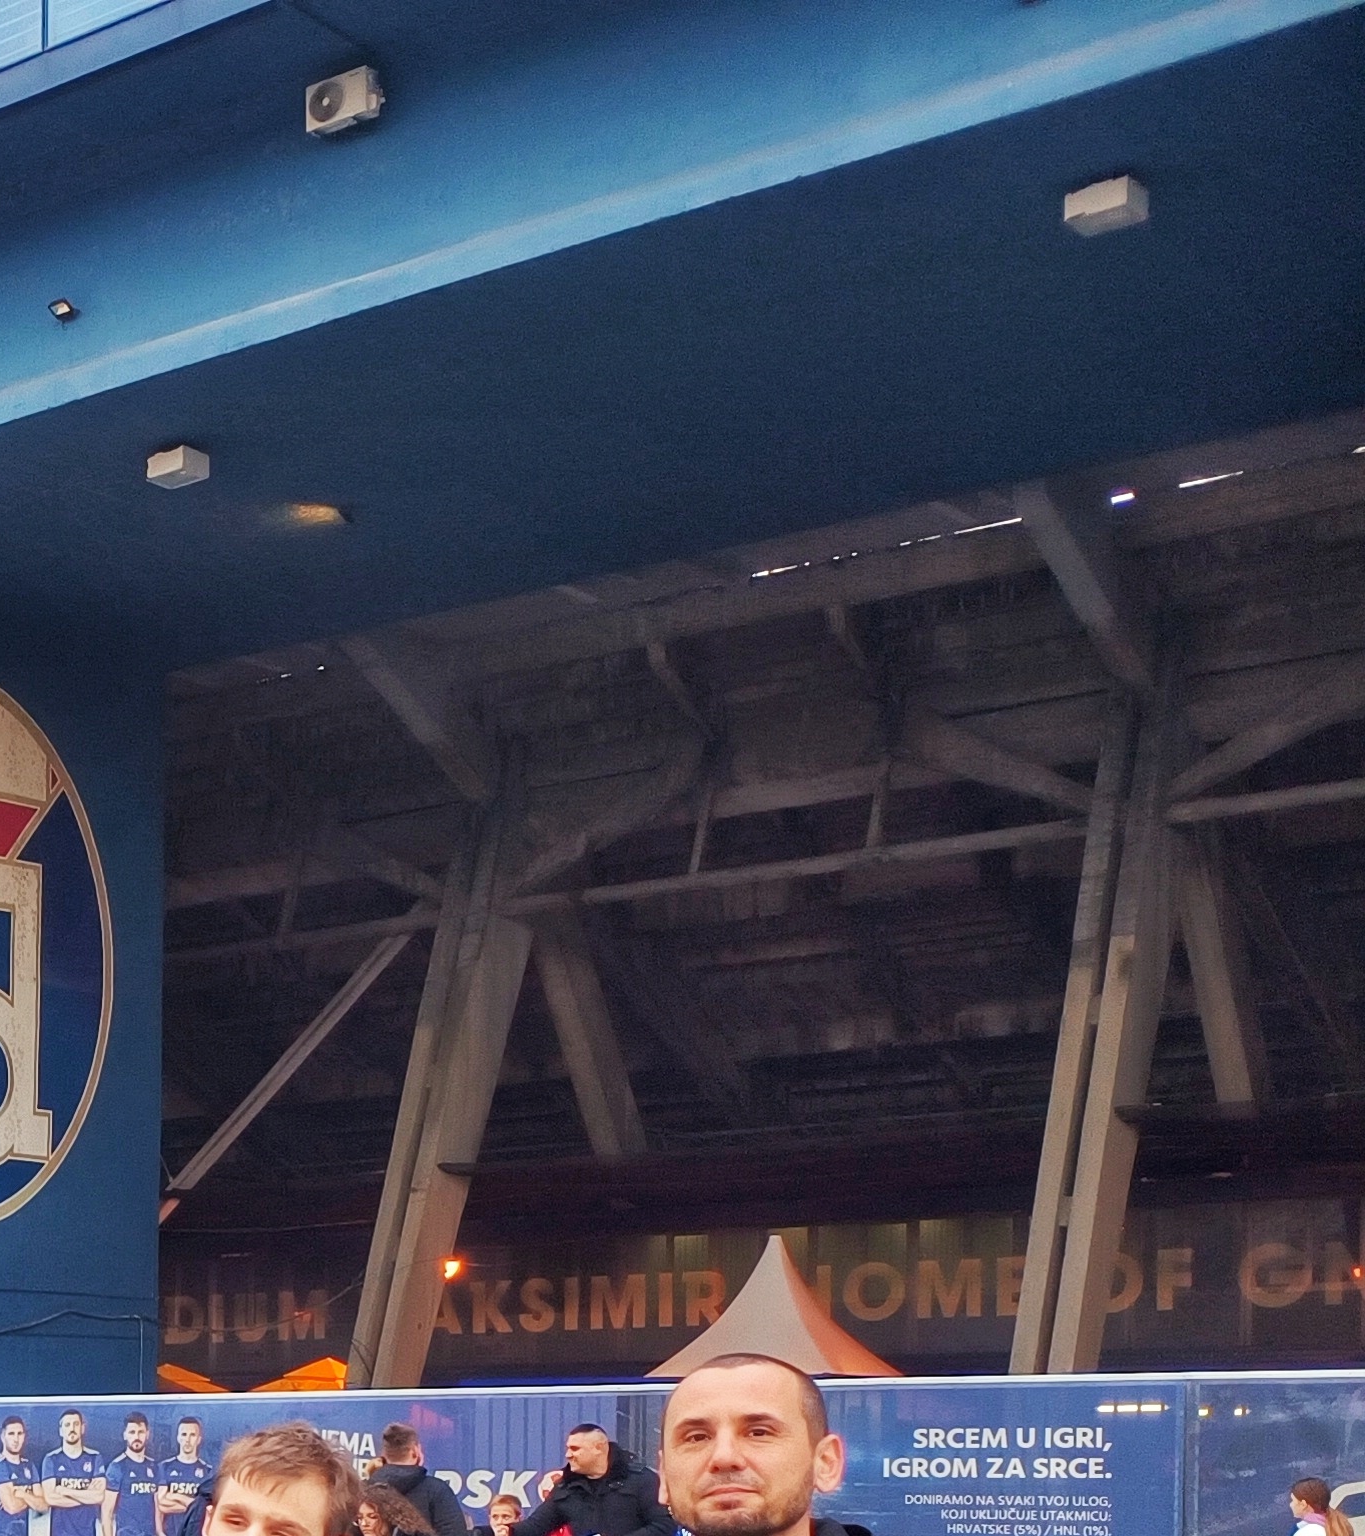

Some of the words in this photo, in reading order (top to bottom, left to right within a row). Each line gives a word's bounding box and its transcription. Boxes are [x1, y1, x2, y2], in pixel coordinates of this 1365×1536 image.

[913, 1428, 1008, 1448] SRCEM
[1016, 1428, 1036, 1448] U
[1044, 1427, 1112, 1451] IGRI,
[882, 1457, 978, 1478] IGROM
[986, 1458, 1026, 1478] ZA
[1033, 1458, 1112, 1479] SRCE.
[904, 1495, 973, 1505] DONIRAMO
[976, 1495, 995, 1505] NA
[998, 1495, 1035, 1506] SVAKI
[1038, 1496, 1069, 1507] TVOJ
[1072, 1496, 1112, 1508] ULOG,
[941, 1509, 967, 1520] KOJI
[970, 1507, 1038, 1521] UKLJUČUJE
[1040, 1510, 1112, 1522] UTAKMICU:
[947, 1524, 1010, 1535] HRVATSKE
[1013, 1524, 1042, 1536] (5%)
[1043, 1525, 1051, 1536] /
[1053, 1525, 1080, 1536] HNL
